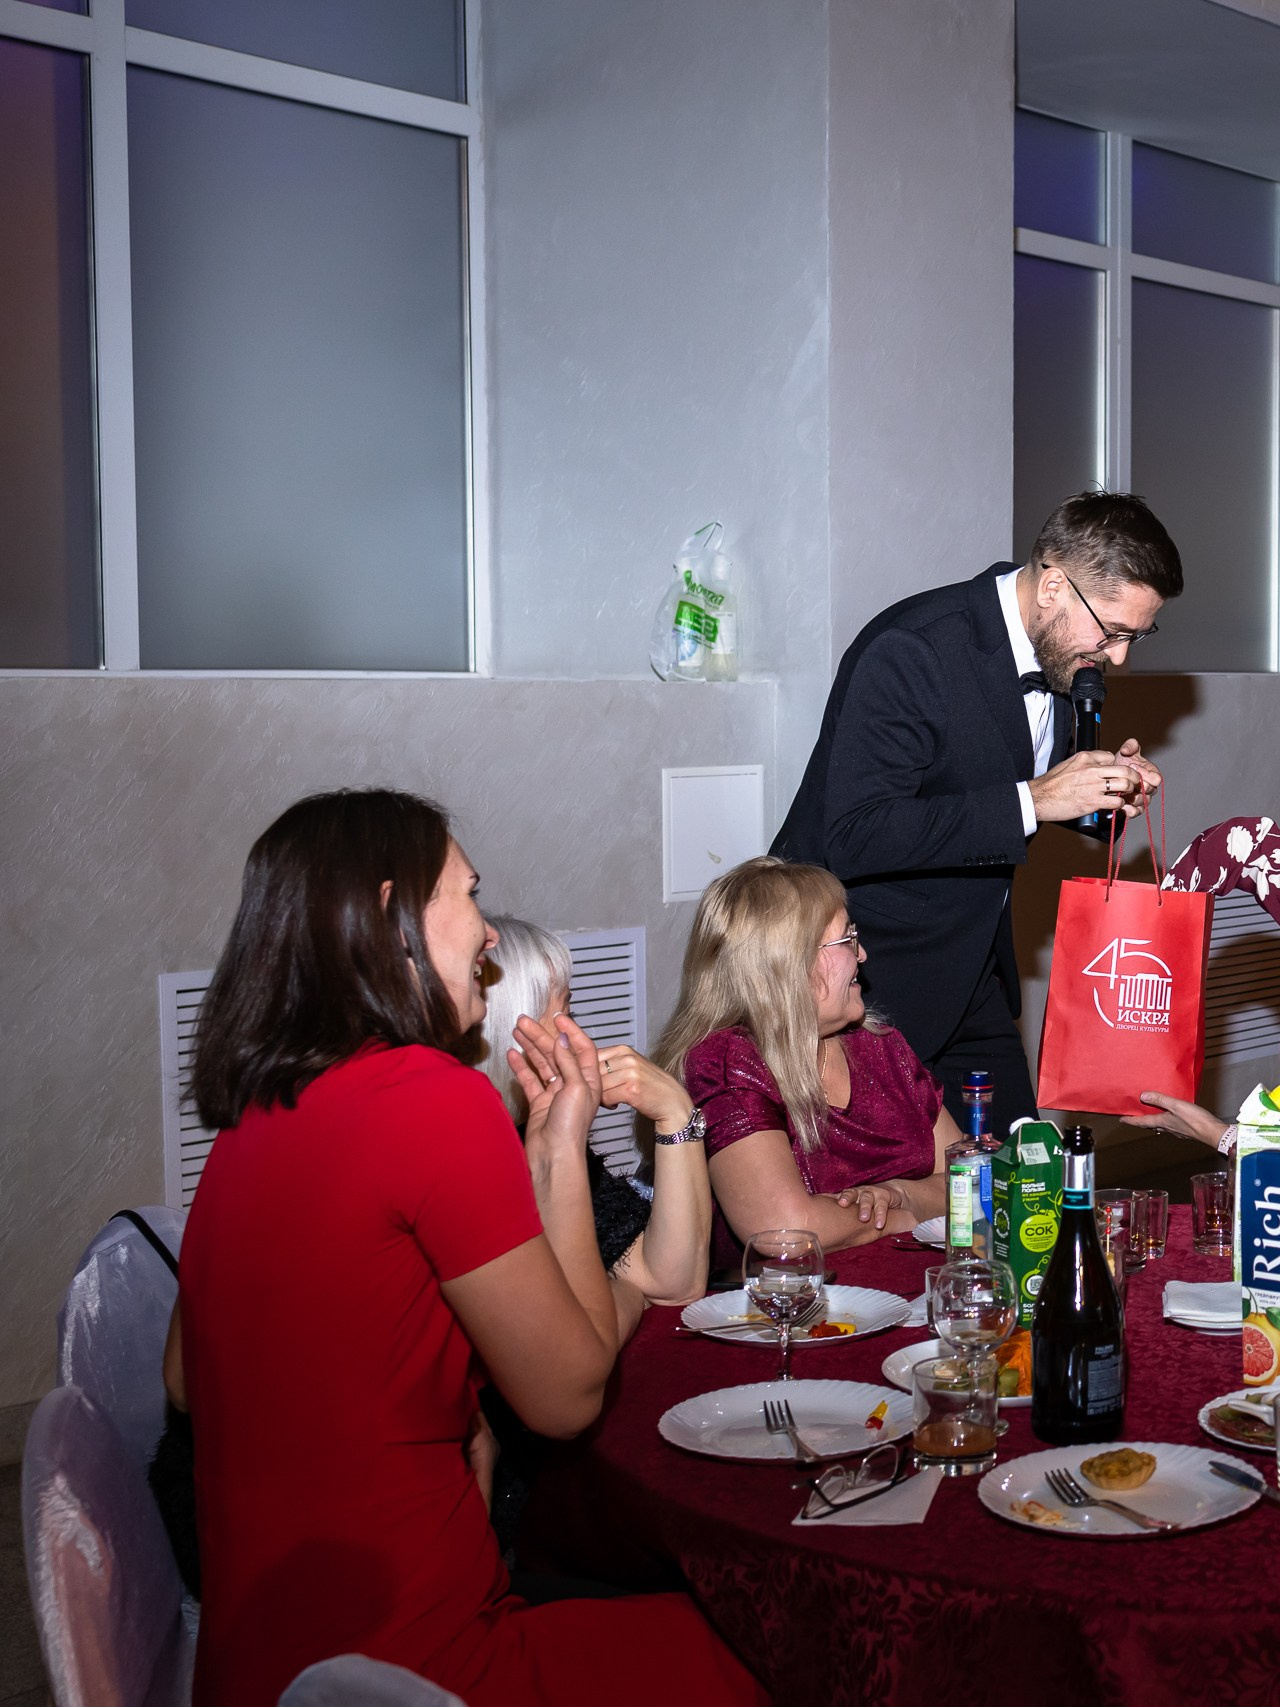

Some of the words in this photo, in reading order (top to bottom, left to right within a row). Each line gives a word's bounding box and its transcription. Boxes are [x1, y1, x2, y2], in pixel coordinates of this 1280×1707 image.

[1081, 937, 1172, 990] 45
[1116, 1009, 1170, 1025] ИСКРА
[1115, 1023, 1139, 1031] ДВОРЕЦ
[1139, 1025, 1170, 1033] КУЛЬТУРЫ
[1025, 1225, 1053, 1236] СОК
